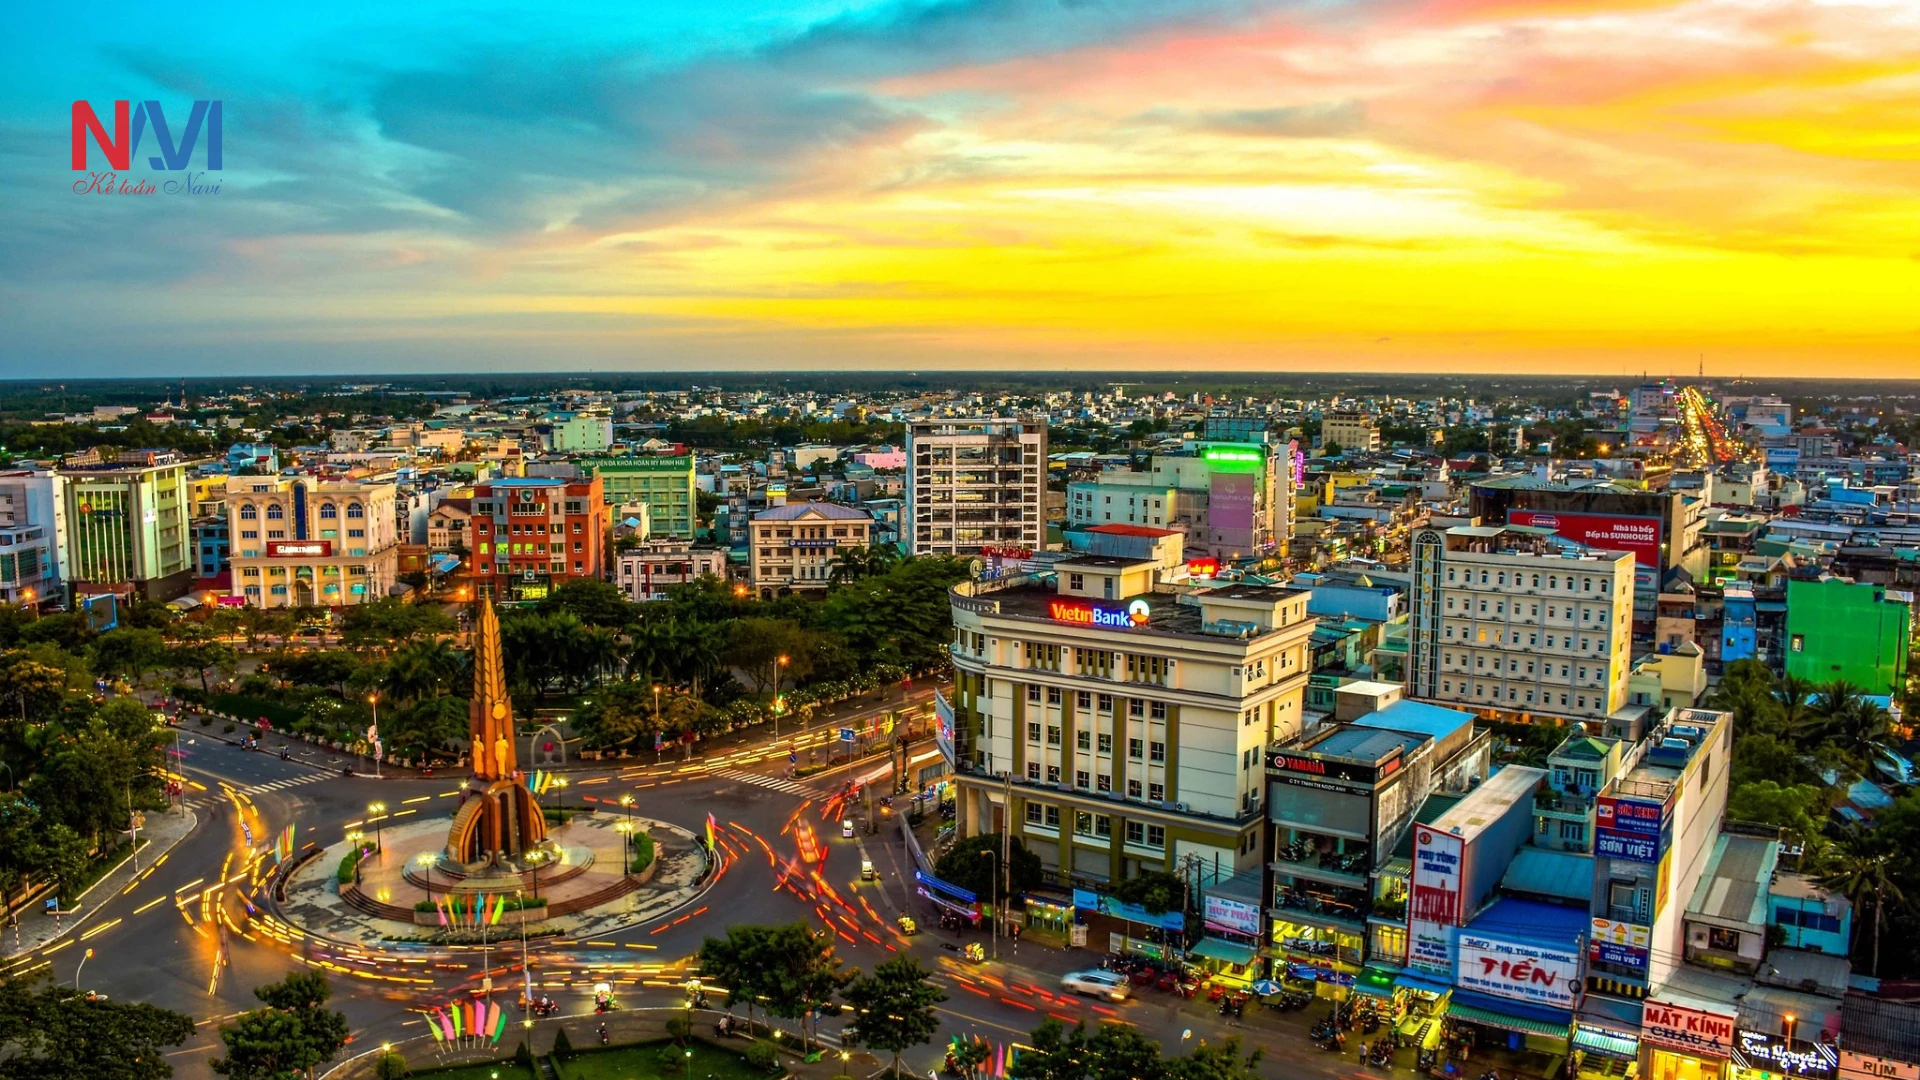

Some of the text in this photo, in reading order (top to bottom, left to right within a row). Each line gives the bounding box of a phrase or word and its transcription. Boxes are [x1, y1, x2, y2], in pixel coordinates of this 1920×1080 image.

[617, 459, 632, 467] KHOA
[660, 459, 674, 467] MINH
[1585, 531, 1654, 541] Bếp là SUNHOUSE
[1613, 524, 1629, 532] Nhà
[1639, 525, 1654, 533] bếp
[1052, 603, 1129, 627] VietinBank
[1419, 631, 1430, 687] HOTEL
[1287, 757, 1325, 774] YAMAHA
[1599, 840, 1623, 853] SƠN
[1626, 844, 1654, 858] VIỆT
[1423, 862, 1452, 874] HONDA
[1208, 905, 1229, 917] HUY
[1496, 944, 1571, 963] PHỤ TÙNG HONDA
[1645, 1008, 1731, 1038] MẮT KÍNH
[1650, 1025, 1702, 1045] CHÂU
[1708, 1036, 1722, 1049] Á
